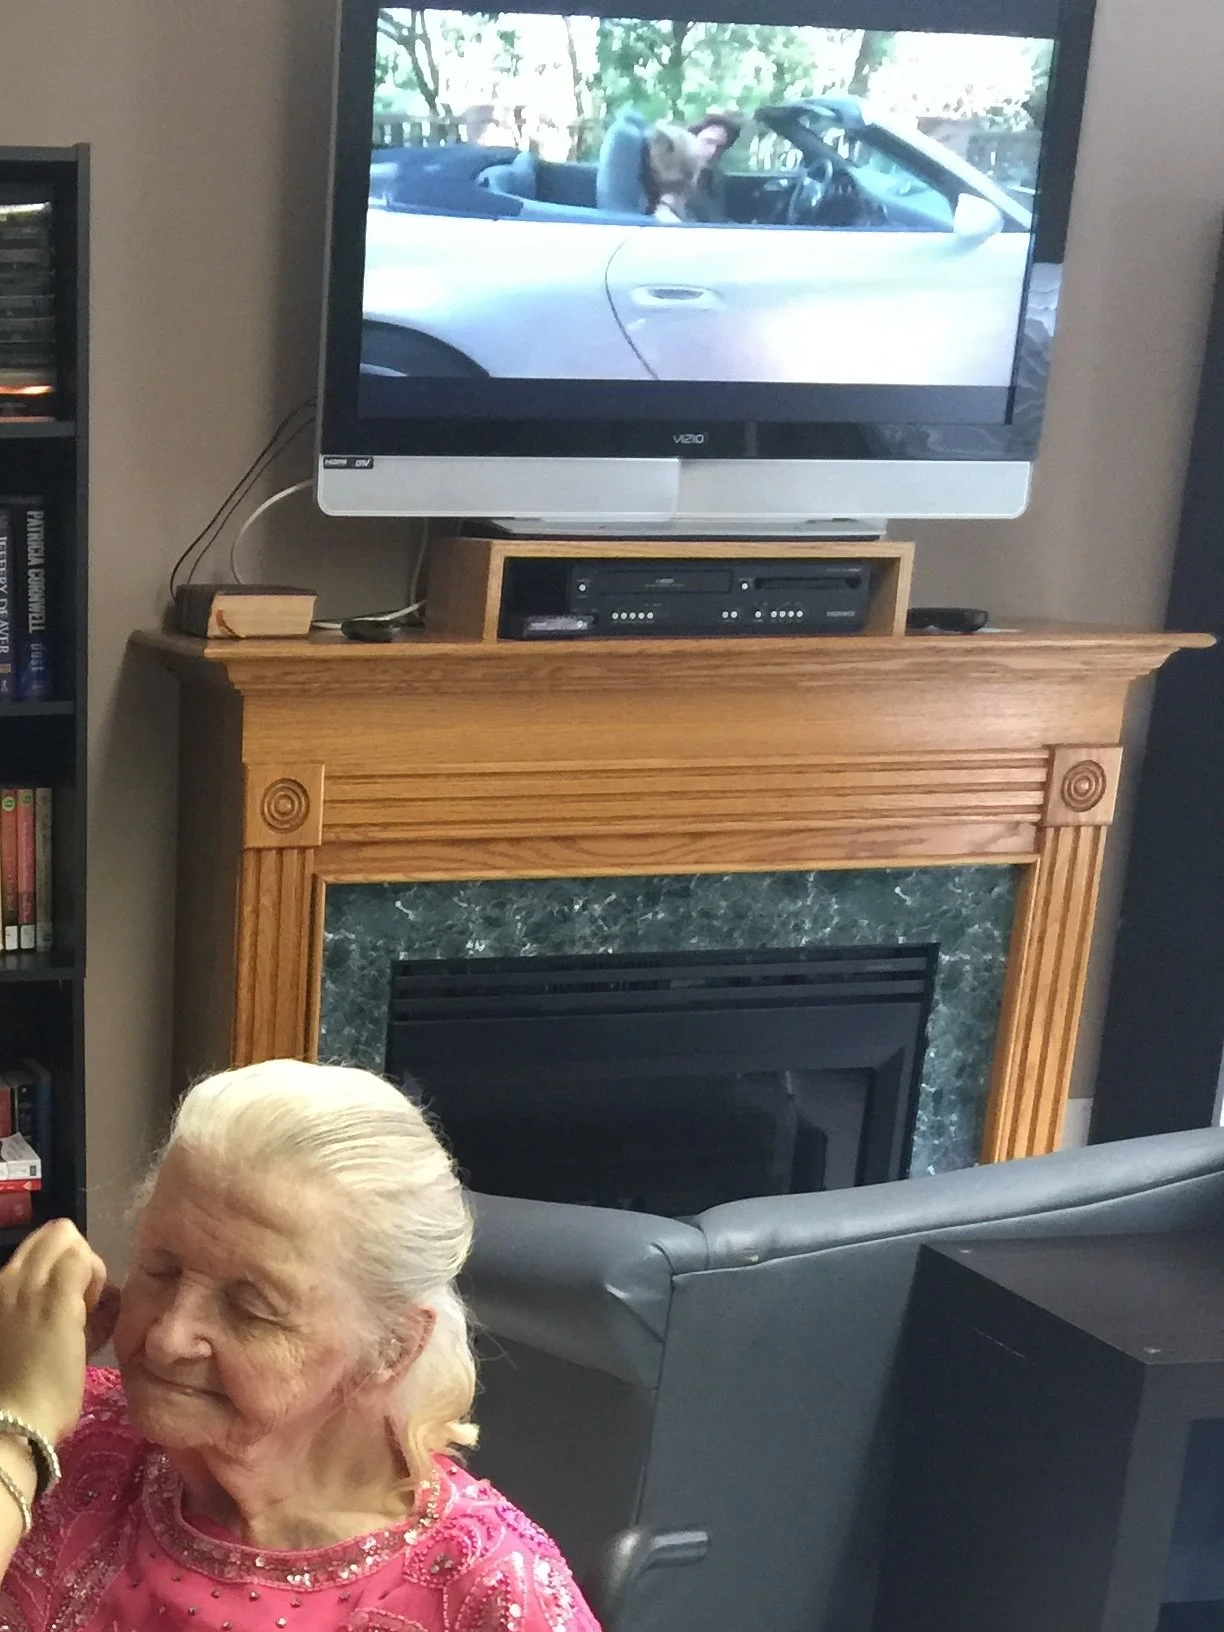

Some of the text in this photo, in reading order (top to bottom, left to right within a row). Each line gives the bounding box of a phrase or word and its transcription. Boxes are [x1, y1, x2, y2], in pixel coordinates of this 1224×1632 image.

[672, 433, 705, 445] VIZIO
[27, 510, 47, 635] PATRICIA CORNWELL
